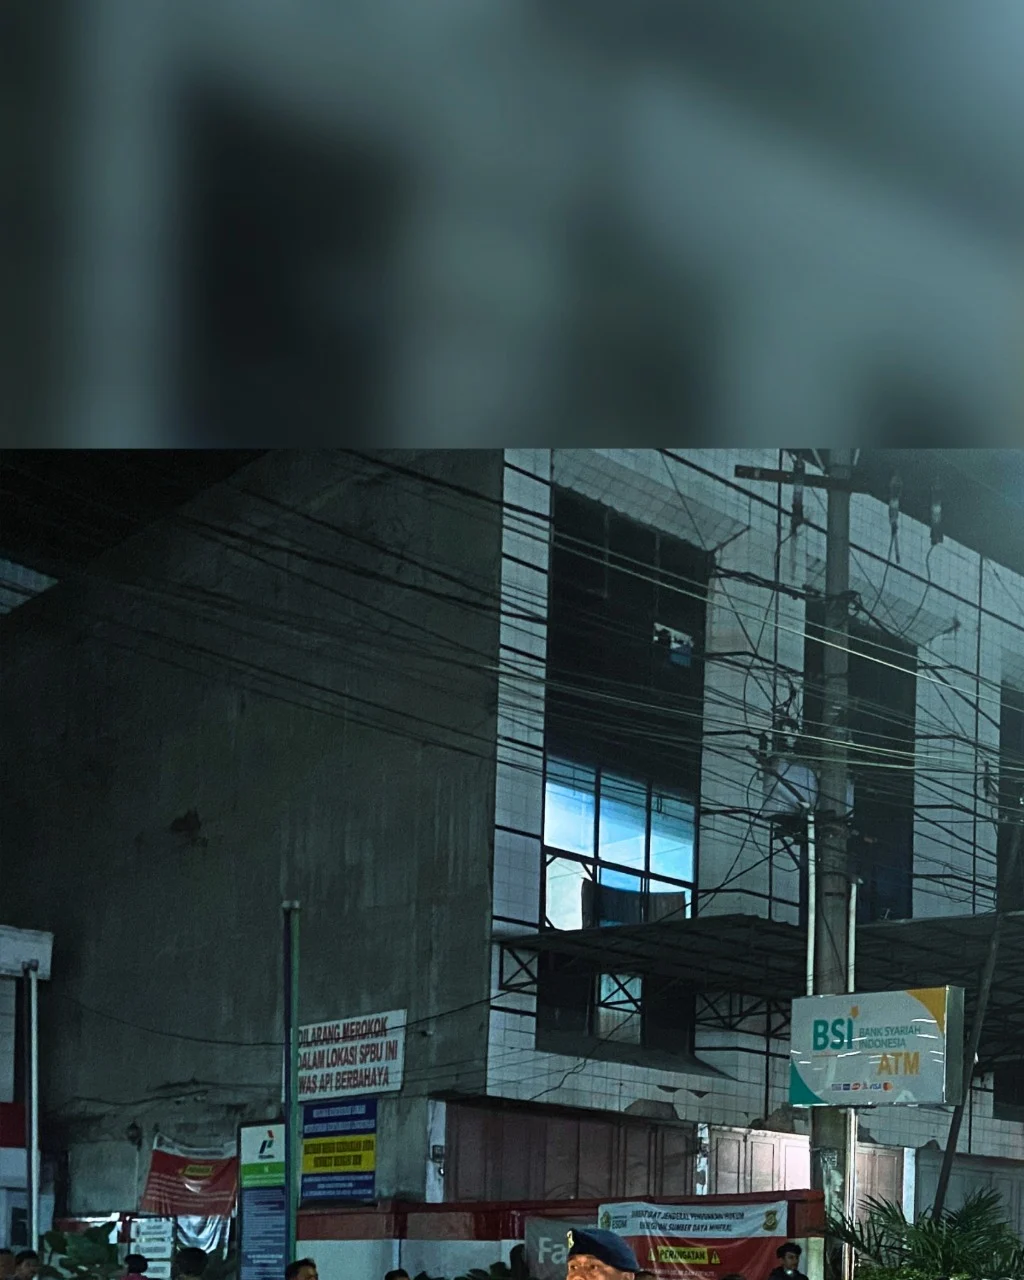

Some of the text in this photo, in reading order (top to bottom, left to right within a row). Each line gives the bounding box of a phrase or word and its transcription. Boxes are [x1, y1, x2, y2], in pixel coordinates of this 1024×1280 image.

[299, 1016, 388, 1048] DILARANG MEROKOK
[812, 1018, 854, 1050] BSI
[858, 1037, 907, 1050] INDONESIA
[859, 1025, 922, 1038] BANK SYARIAH
[298, 1039, 399, 1071] DALAM LOKASI SPBU INI
[876, 1052, 920, 1076] ATM
[298, 1065, 390, 1095] WAS API BERBAHAYA
[538, 1236, 566, 1265] Fa
